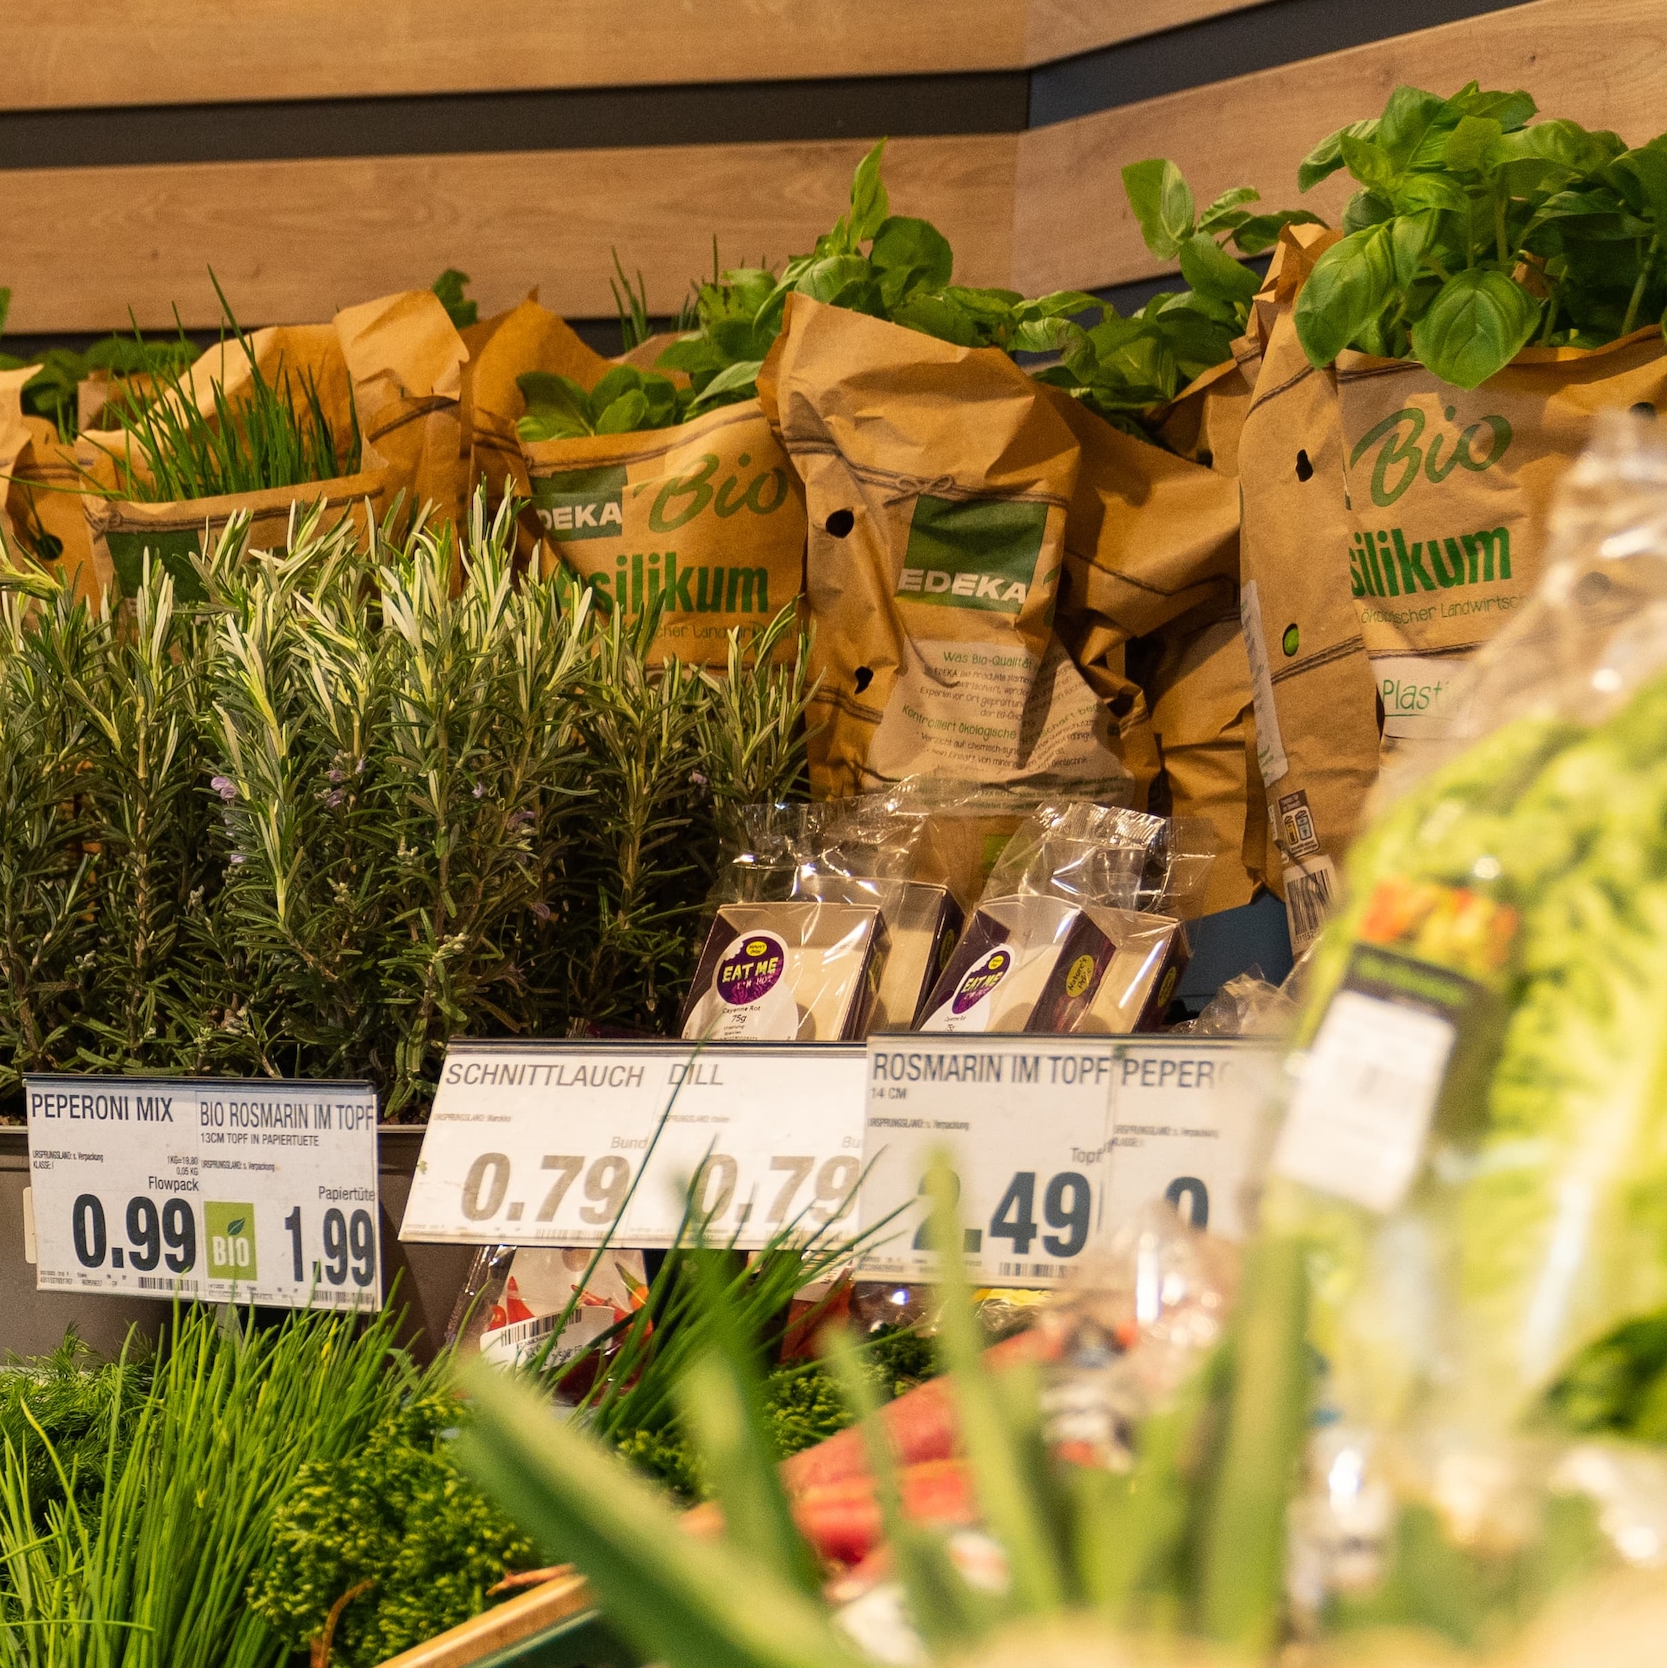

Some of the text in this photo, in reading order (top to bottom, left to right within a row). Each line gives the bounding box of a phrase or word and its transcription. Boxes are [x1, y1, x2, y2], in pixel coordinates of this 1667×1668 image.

[1350, 405, 1512, 507] Bio
[633, 452, 788, 533] Bio
[897, 568, 1028, 604] EDEKA
[943, 651, 1032, 668] Was Bio-Qualität
[902, 706, 1017, 742] Kontrolliert ökologische
[722, 957, 778, 983] EAT ME
[962, 972, 1004, 993] EAT ME
[722, 1006, 748, 1014] Cayenne
[732, 1014, 747, 1023] 75g
[445, 1064, 644, 1087] SCHNITTLAUCH
[667, 1064, 724, 1086] DILL
[873, 1053, 1110, 1085] ROSMARIN IM TOPF
[31, 1094, 174, 1122] PEPERONI MIX
[200, 1101, 374, 1131] BIO ROSMARIN IM TOPF
[200, 1133, 319, 1147] 13CM TOPF PAPIERTUETE
[611, 1136, 648, 1149] Bund
[1070, 1147, 1104, 1164] Topf
[149, 1176, 199, 1192] Flowpack
[318, 1186, 376, 1202] Papiertüte
[461, 1153, 630, 1223] 0.79
[692, 1153, 860, 1224] 0.79
[73, 1194, 196, 1273] 0.99
[285, 1206, 374, 1286] 1.99
[213, 1236, 250, 1267] BIO
